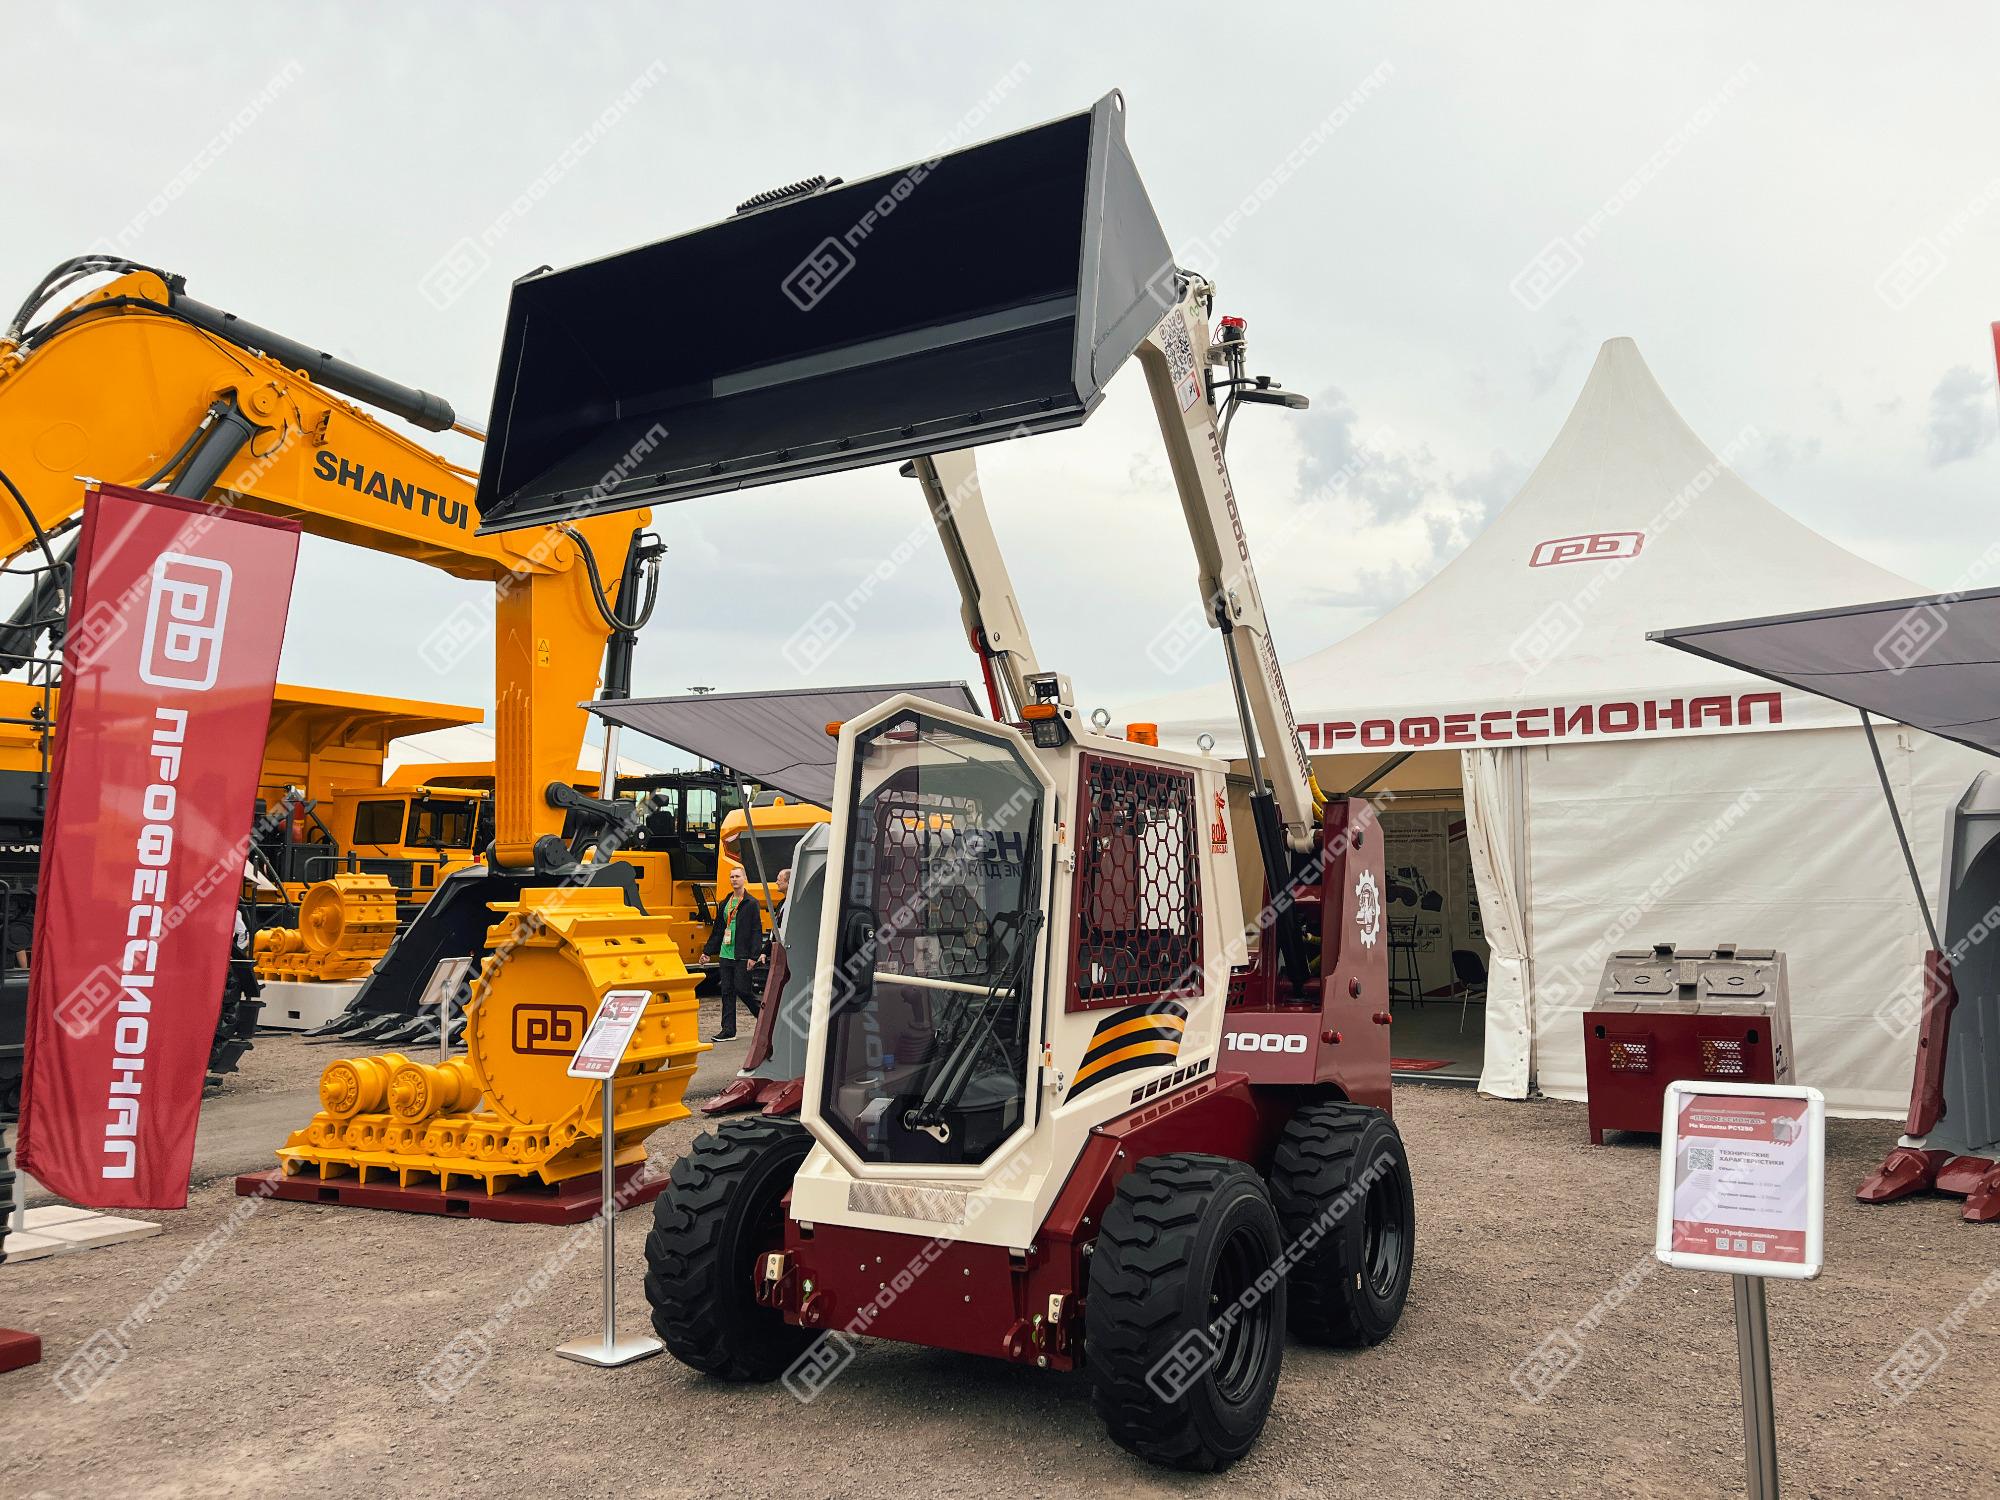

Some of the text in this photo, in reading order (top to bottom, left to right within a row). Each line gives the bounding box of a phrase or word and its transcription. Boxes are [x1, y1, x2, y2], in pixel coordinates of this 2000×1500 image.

[313, 450, 468, 530] SHANTUI
[1263, 632, 1308, 787] ПРОФЕССИОНАЛ
[1298, 691, 1782, 750] ПРОФЕССИОНАЛ
[102, 707, 188, 1180] ПРОФЕССИОНАЛ
[1223, 1032, 1308, 1053] 1000
